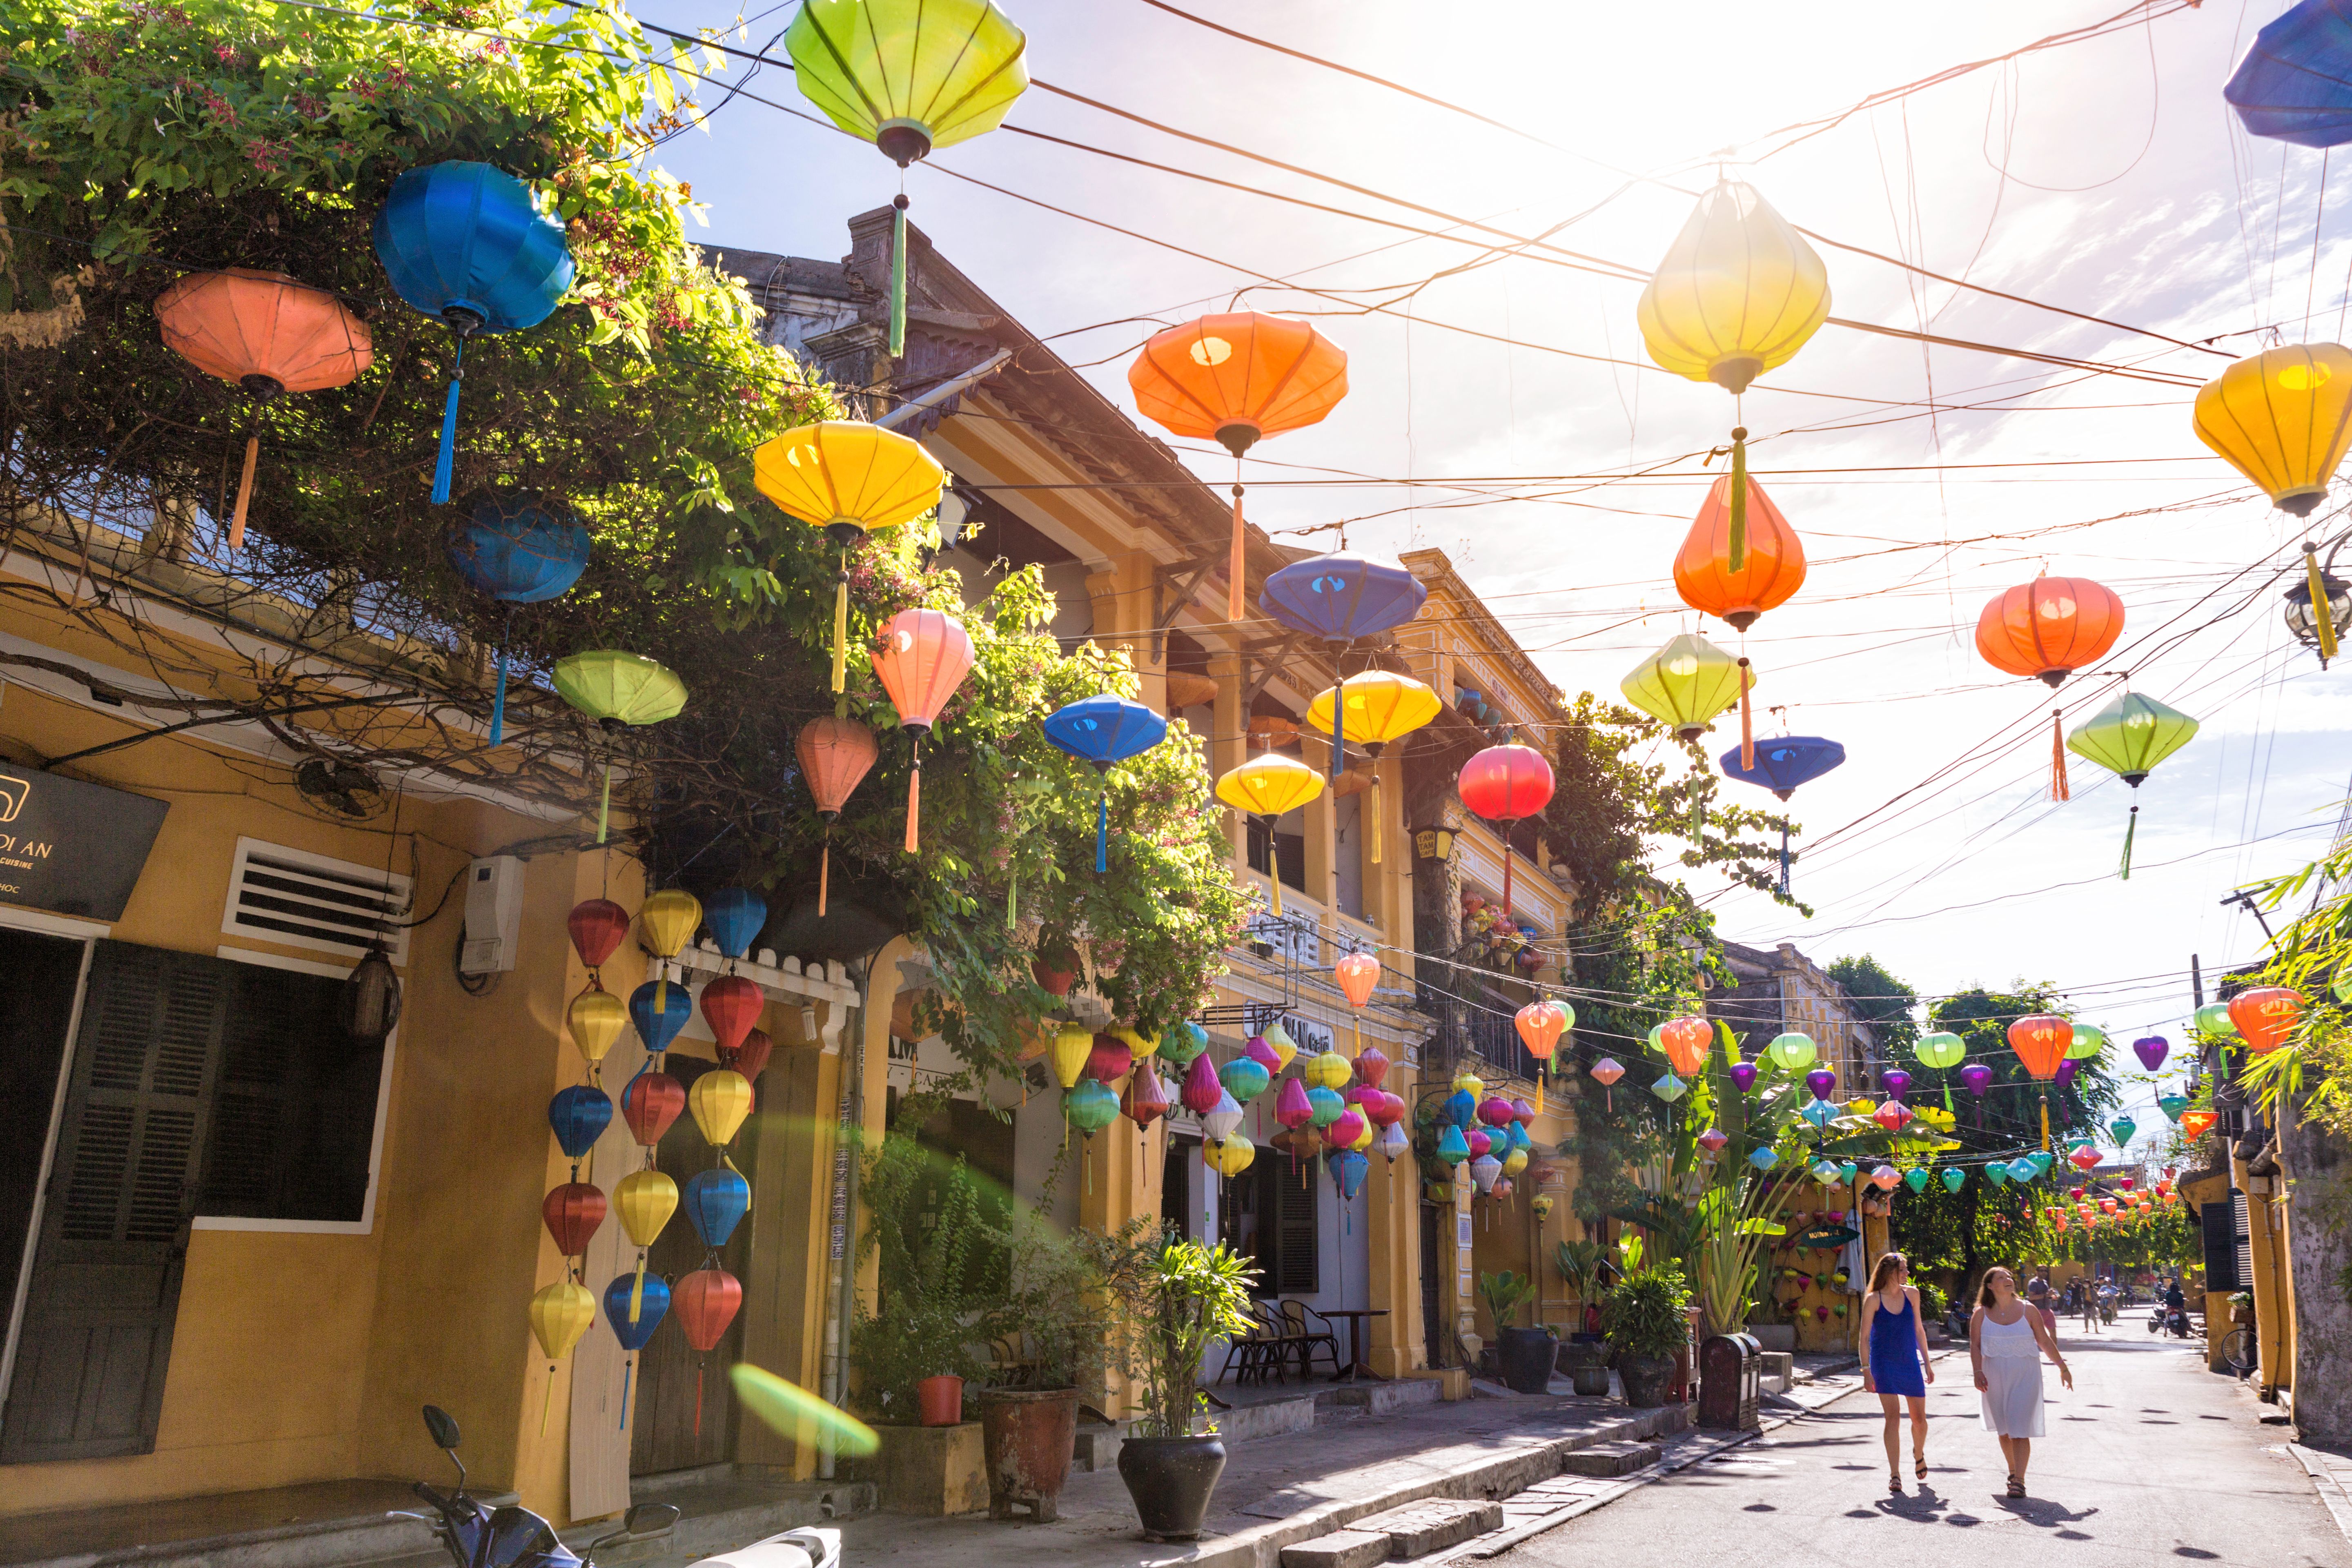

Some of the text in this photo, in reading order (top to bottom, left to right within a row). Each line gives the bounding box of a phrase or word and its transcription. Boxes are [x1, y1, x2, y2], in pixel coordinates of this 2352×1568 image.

[1418, 833, 1434, 843] TAM
[20, 840, 53, 858] AN
[1419, 842, 1434, 850] TAM
[0, 858, 33, 869] CUISINE
